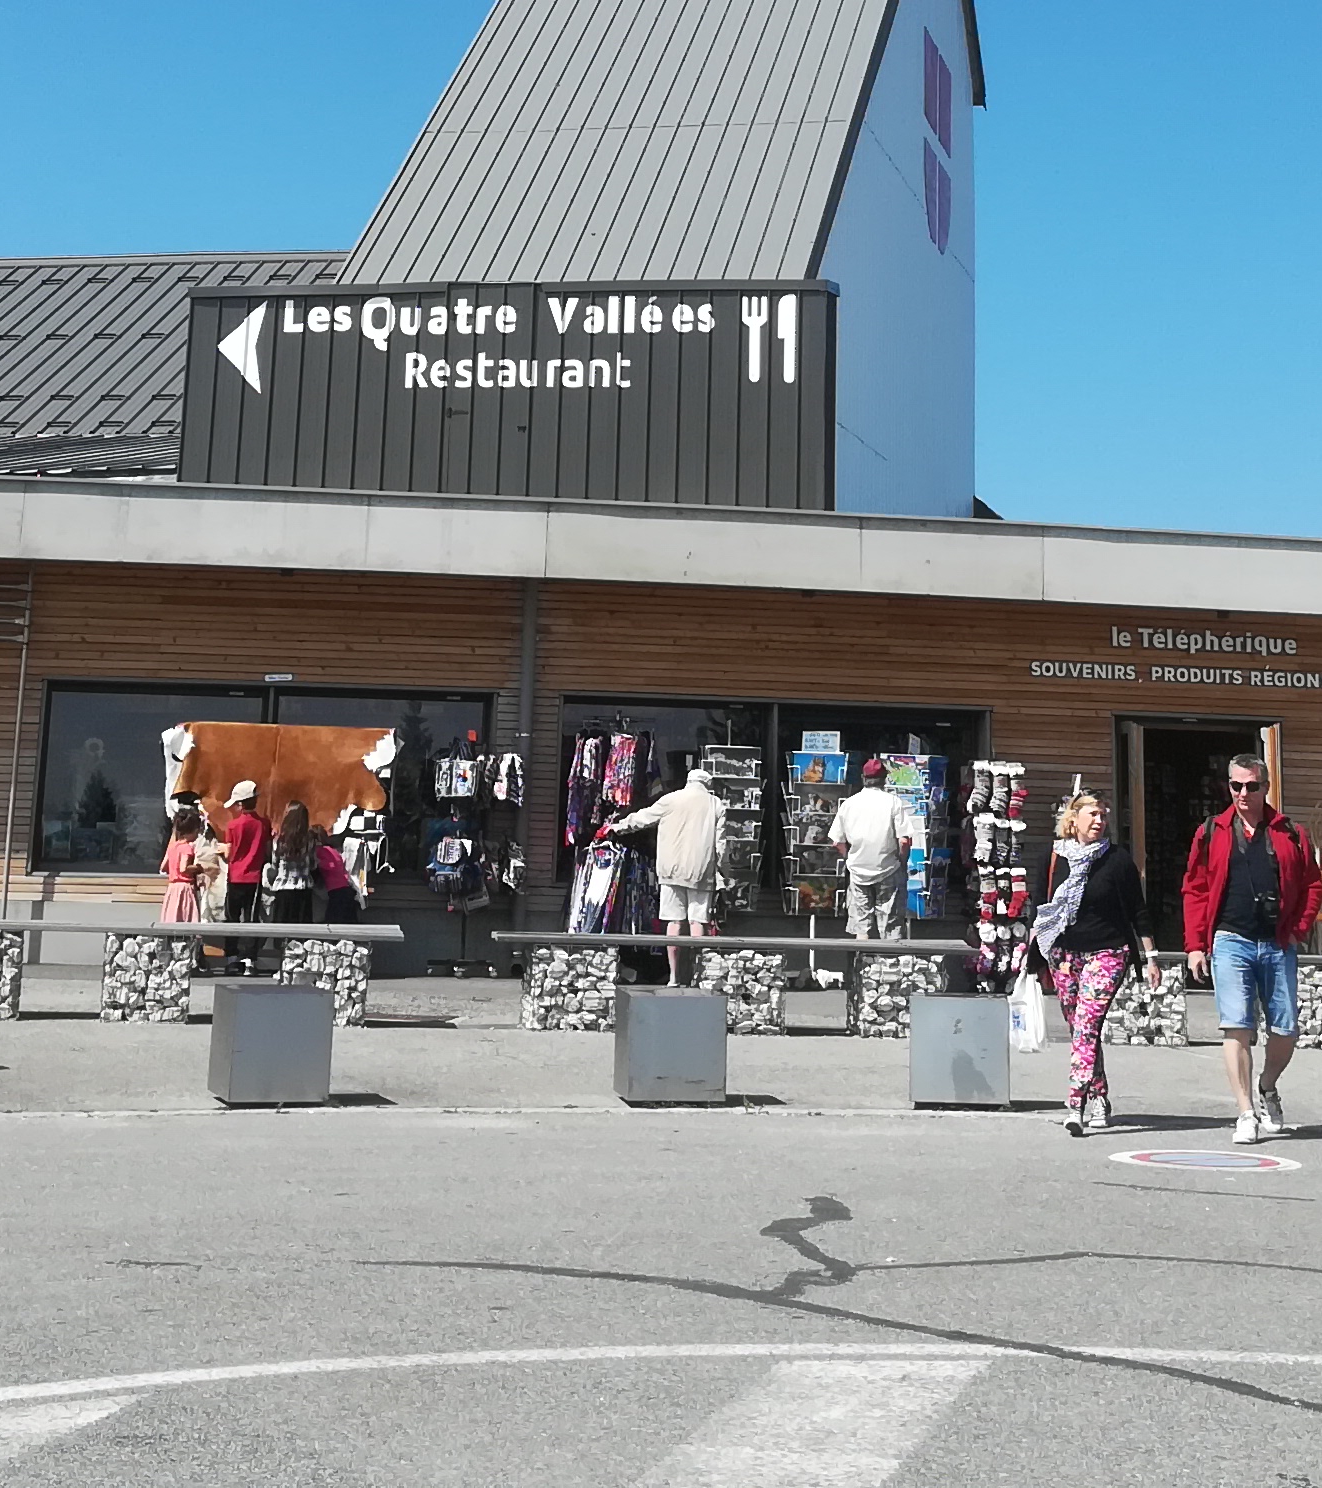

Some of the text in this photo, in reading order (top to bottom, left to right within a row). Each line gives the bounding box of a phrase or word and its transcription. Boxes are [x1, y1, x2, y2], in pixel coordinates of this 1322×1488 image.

[283, 295, 716, 352] Les Quatre Vallées
[404, 351, 632, 389] Restaurant
[1111, 625, 1297, 657] le Téléphérique
[1151, 666, 1243, 685] PRODUITS
